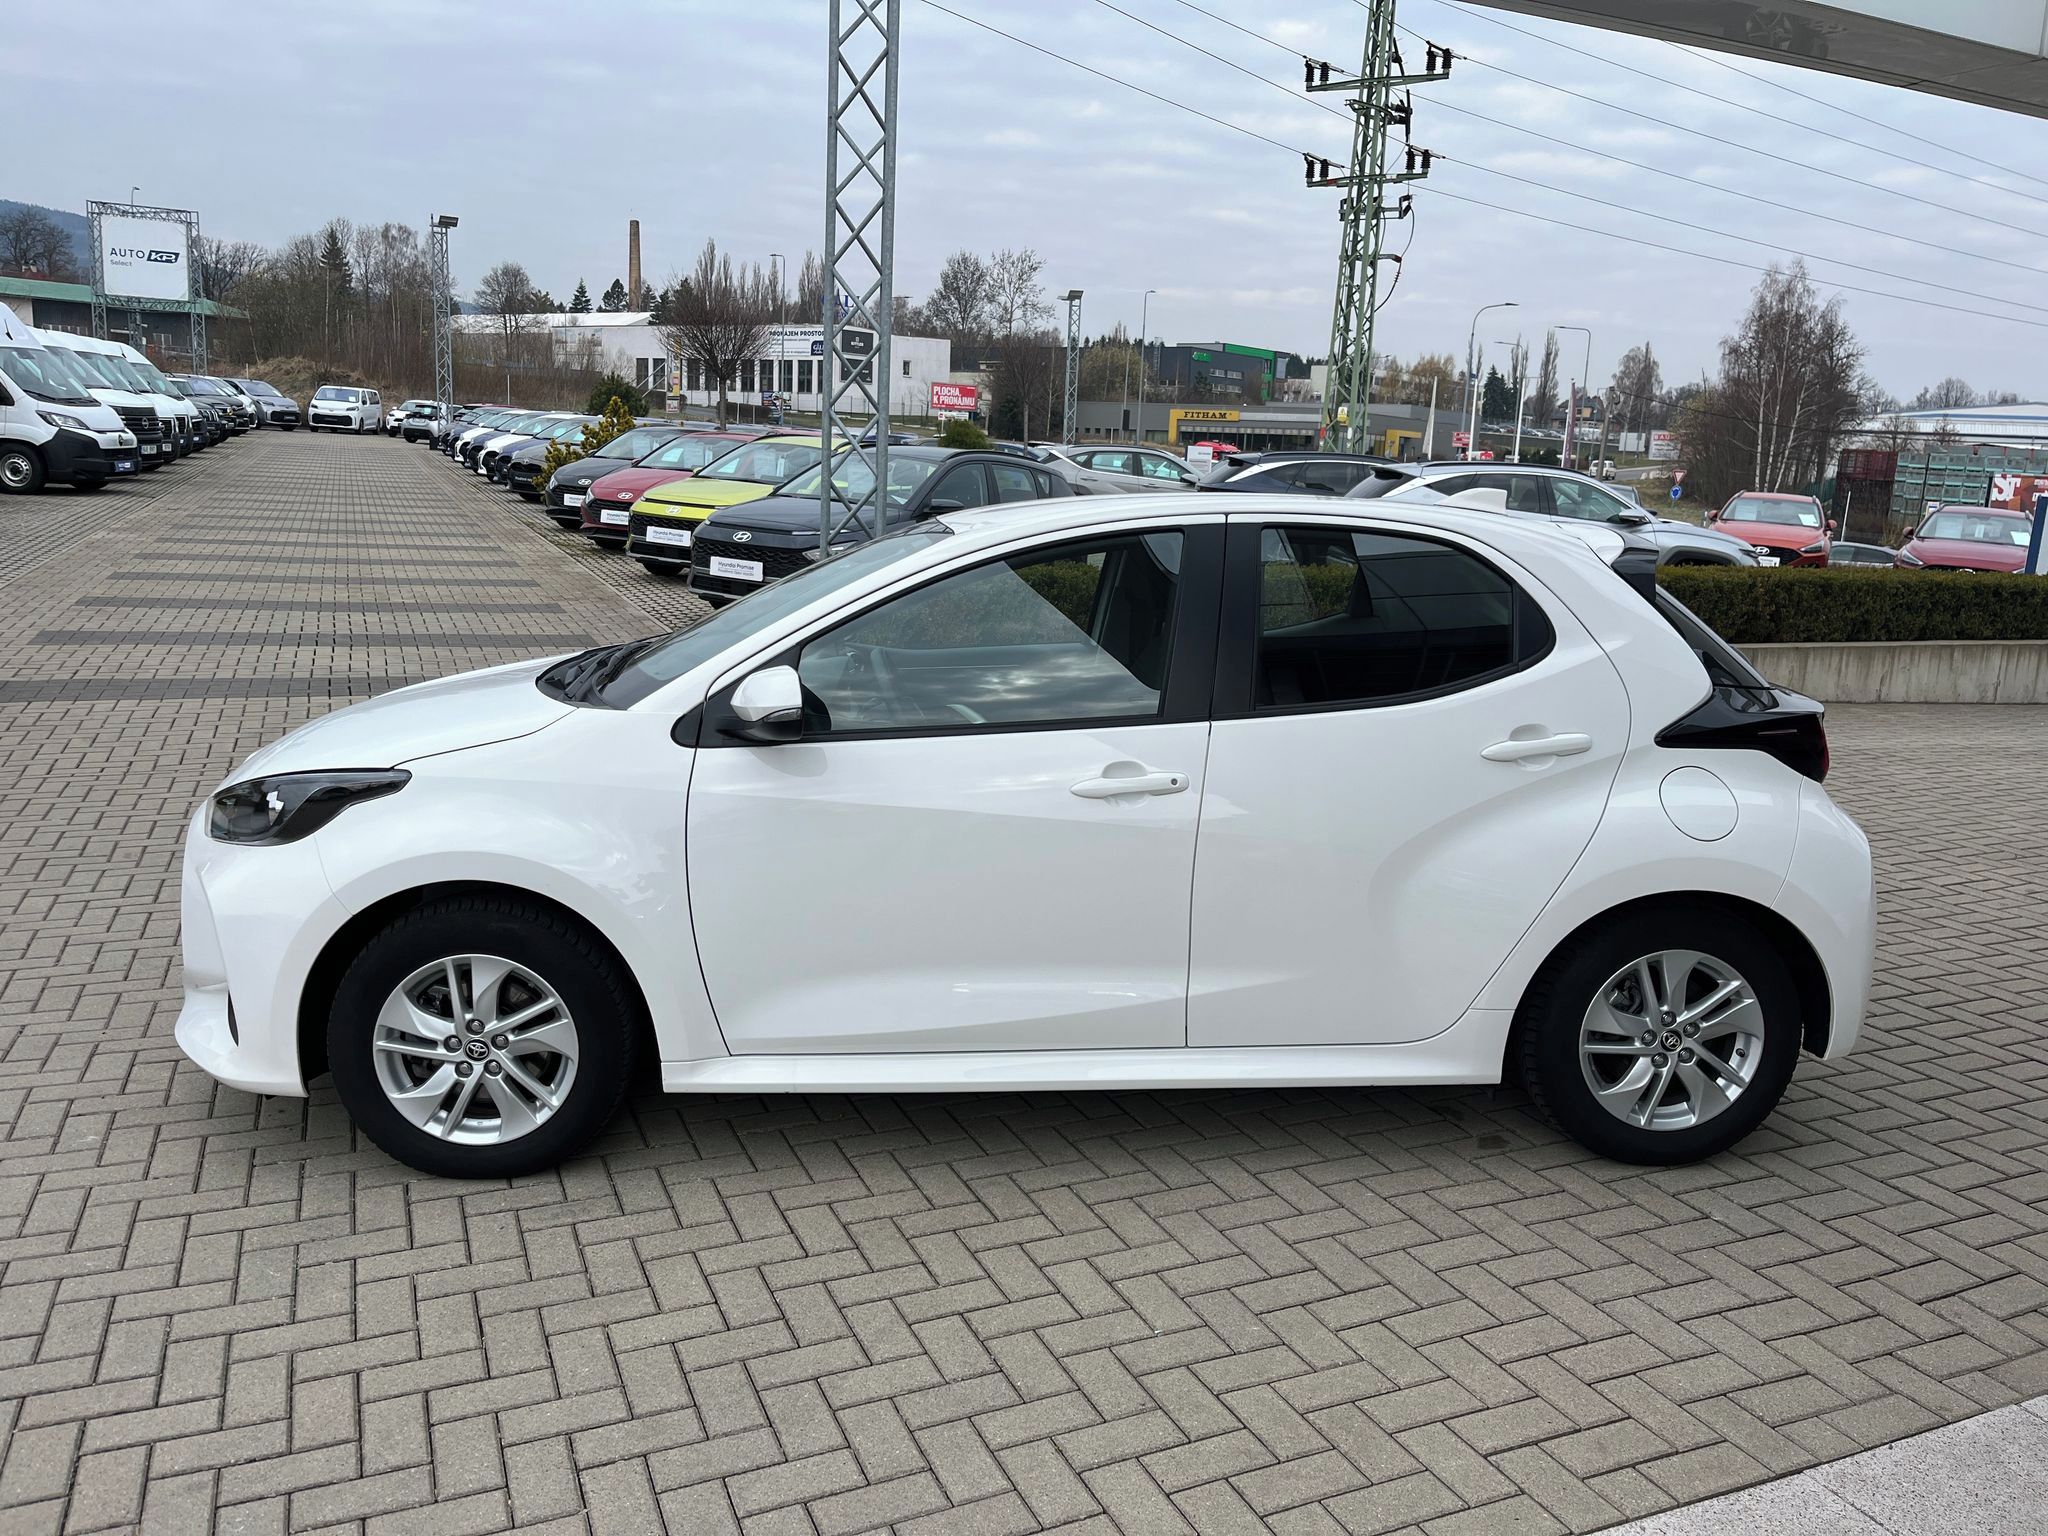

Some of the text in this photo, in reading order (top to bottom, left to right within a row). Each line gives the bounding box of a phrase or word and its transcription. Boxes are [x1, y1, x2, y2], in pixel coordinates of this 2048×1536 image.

[110, 247, 145, 259] AUTO
[110, 259, 132, 267] Select
[933, 395, 939, 404] K
[1183, 411, 1228, 419] FITHAM
[718, 561, 736, 569] Hyundai
